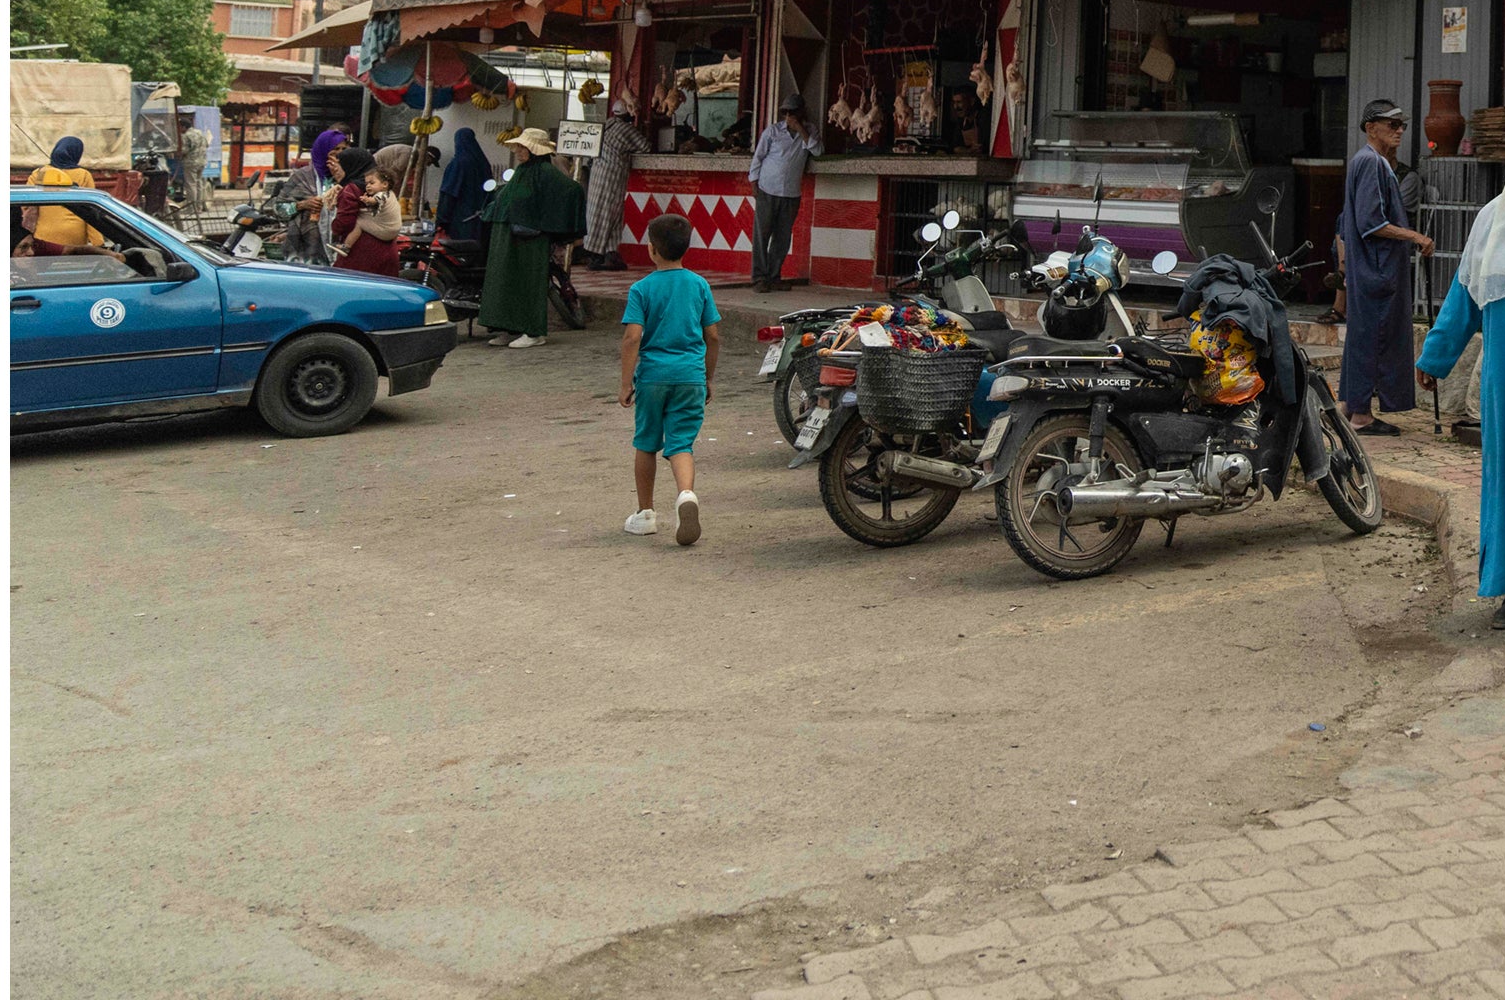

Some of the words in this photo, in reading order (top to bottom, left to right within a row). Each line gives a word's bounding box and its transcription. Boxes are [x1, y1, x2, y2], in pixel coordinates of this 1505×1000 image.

[562, 140, 580, 149] PETIT
[580, 140, 594, 151] TAXI
[102, 307, 113, 318] 9
[1146, 358, 1171, 368] DOCKER
[1096, 378, 1131, 387] DOCKER
